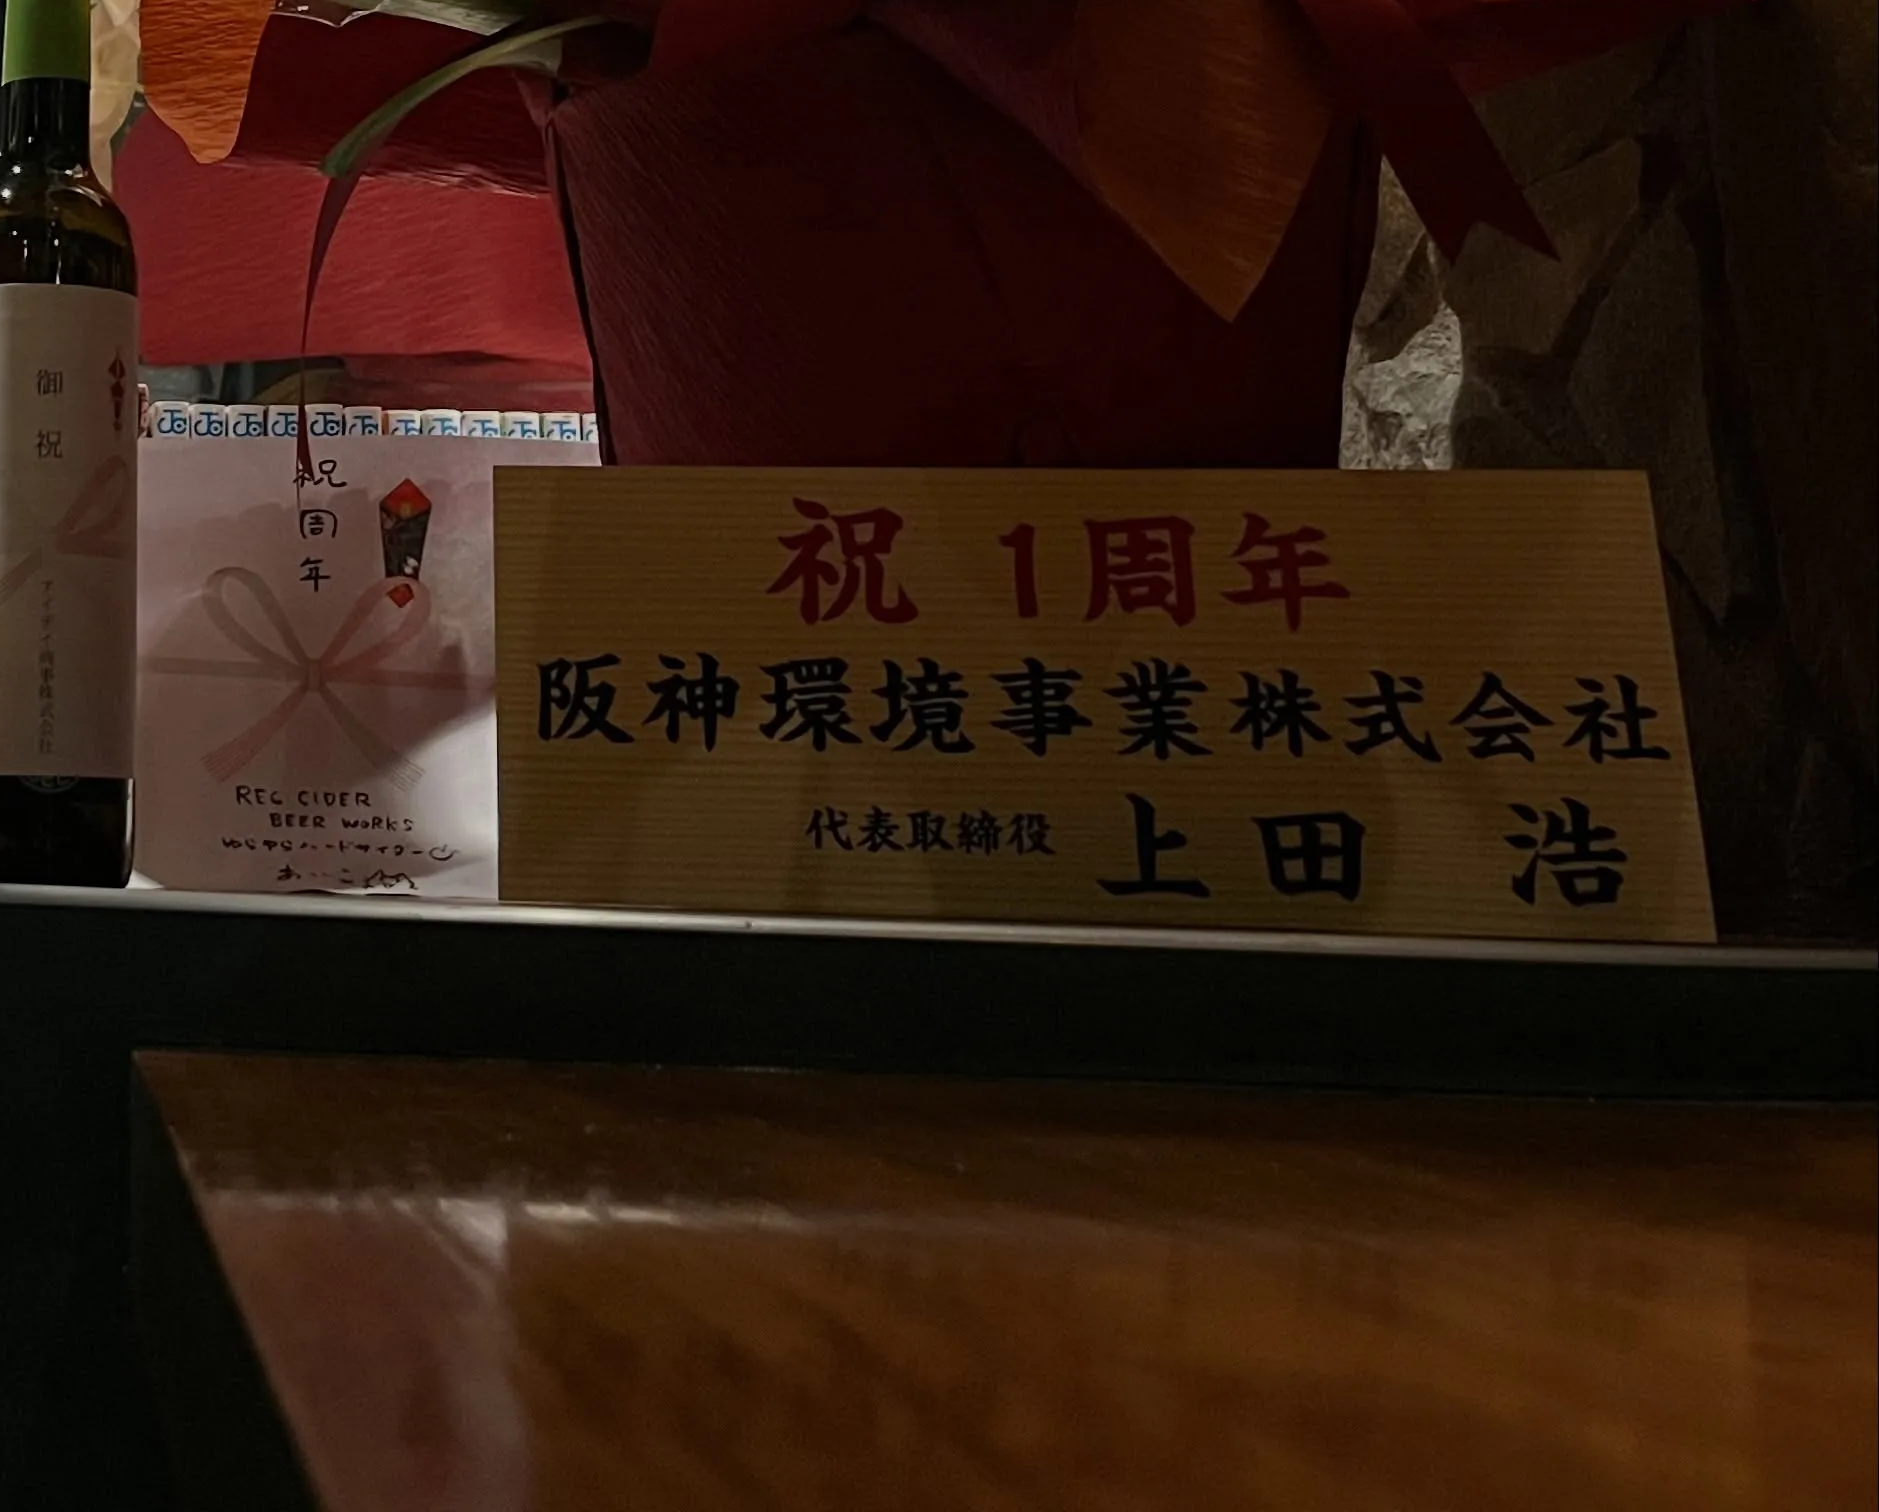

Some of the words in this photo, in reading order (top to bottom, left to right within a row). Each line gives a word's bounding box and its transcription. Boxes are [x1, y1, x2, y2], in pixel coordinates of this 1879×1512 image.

[36, 368, 63, 459] 御祝
[768, 496, 918, 626] 祝
[1000, 510, 1350, 632] 1周年
[536, 652, 1672, 766] 阪神環境事業株式会社
[270, 813, 325, 829] BEER
[298, 790, 371, 807] CIDER
[806, 804, 1055, 859] 代表取締役
